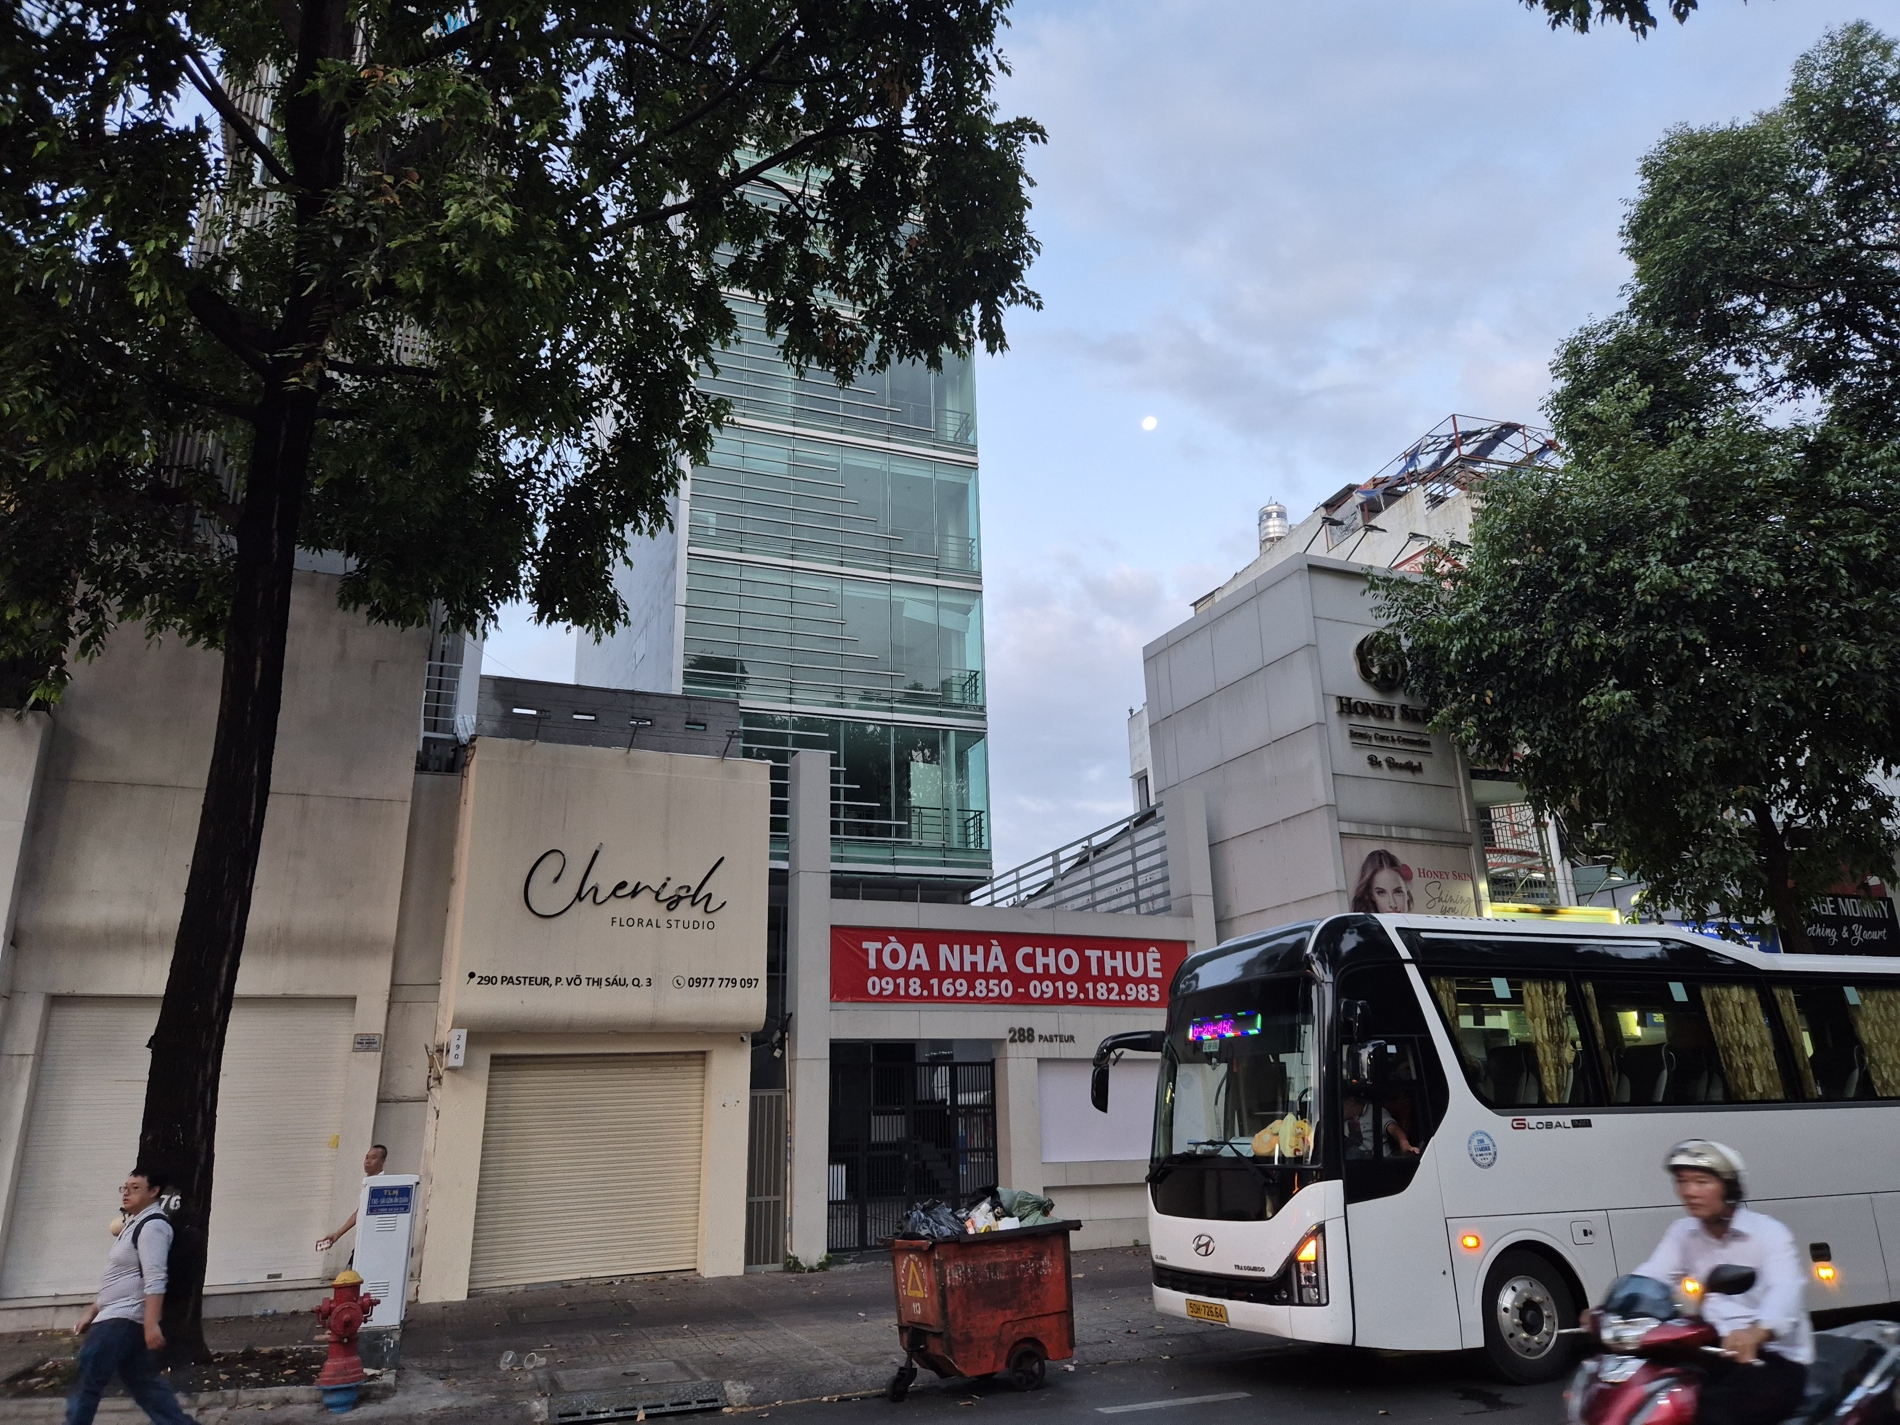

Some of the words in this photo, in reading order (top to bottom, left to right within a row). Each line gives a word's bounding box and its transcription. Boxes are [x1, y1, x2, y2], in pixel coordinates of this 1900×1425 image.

[523, 842, 727, 919] Cherish
[1417, 868, 1449, 880] HONEY
[1451, 870, 1475, 882] SKIN
[1424, 880, 1474, 917] Shining
[611, 916, 661, 928] FLORAL
[666, 918, 716, 930] STUDIO
[1842, 925, 1849, 938] &
[862, 935, 931, 971] TÒA
[939, 939, 1009, 973] NHÀ
[1015, 946, 1080, 975] CHO
[1084, 946, 1163, 978] THUÊ
[476, 975, 498, 986] 290
[500, 975, 552, 988] PASTEUR,
[554, 976, 563, 986] P.
[565, 974, 582, 986] VÕ
[585, 976, 602, 989] THỊ
[604, 975, 629, 988] SÁU,
[631, 977, 643, 987] Q.
[645, 977, 652, 987] 3
[687, 976, 715, 988] 0977
[718, 977, 737, 988] 779
[739, 977, 759, 988] 097
[867, 976, 1013, 998] 0918.169.850
[1029, 979, 1160, 1002] 0919.182.983
[1008, 1027, 1035, 1043] 288
[1038, 1034, 1075, 1043] PASTEUR
[1511, 1118, 1571, 1130] GLOBAL
